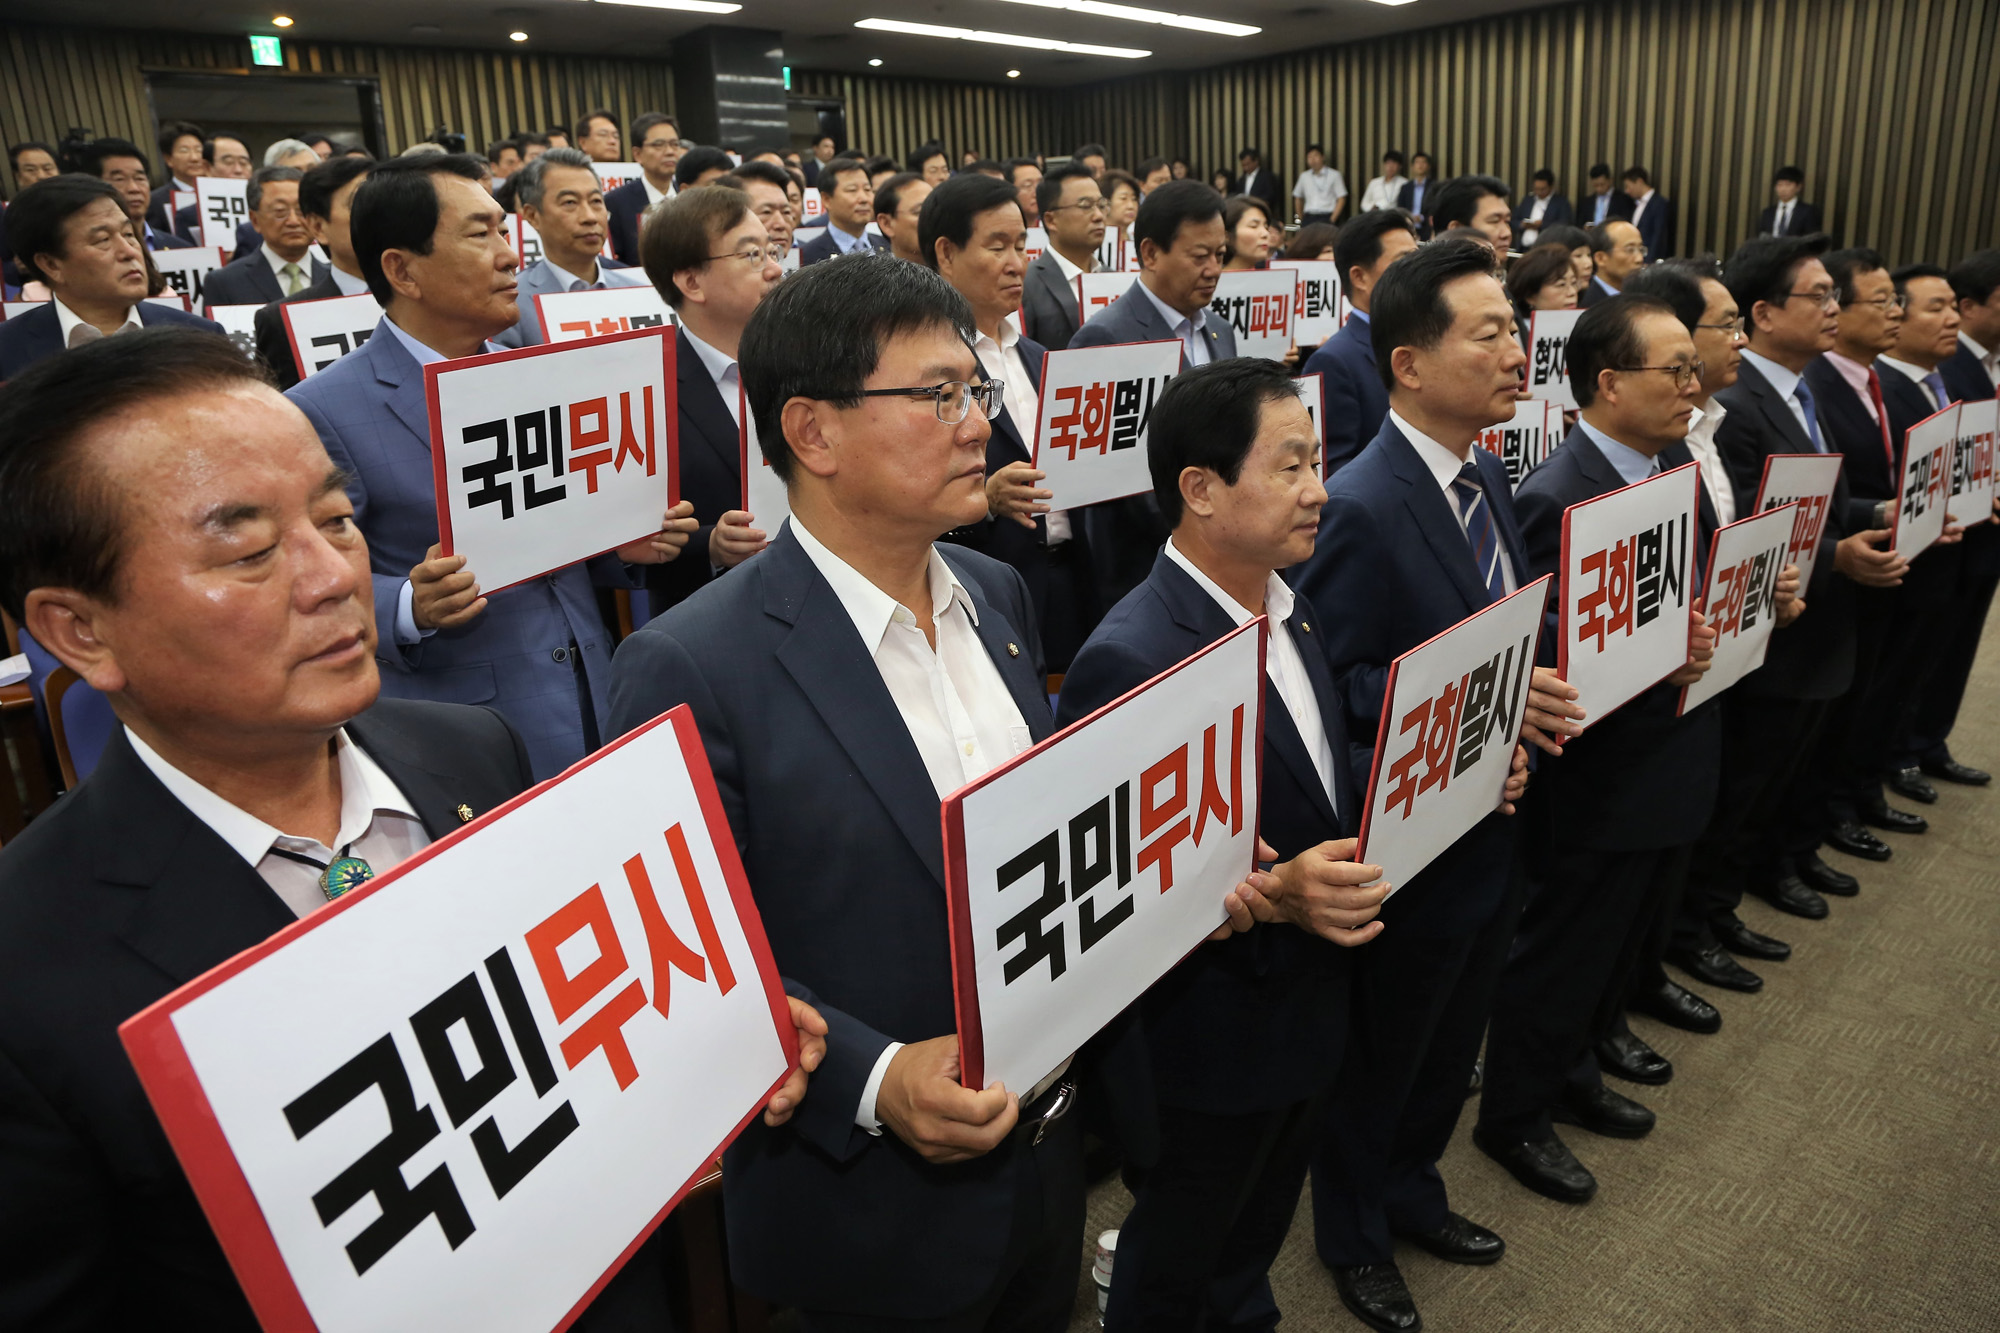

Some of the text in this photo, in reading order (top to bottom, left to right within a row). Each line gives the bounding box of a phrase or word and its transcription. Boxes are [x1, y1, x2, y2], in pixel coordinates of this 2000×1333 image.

[462, 385, 656, 520] 국민무시
[1903, 438, 1955, 523] 국민무시
[1578, 512, 1687, 653] 국회멸시
[1707, 542, 1786, 648] 국회멸시
[1384, 634, 1530, 821] 국회멸시
[996, 703, 1244, 986] 국민무시
[282, 822, 737, 1277] 국민무시
